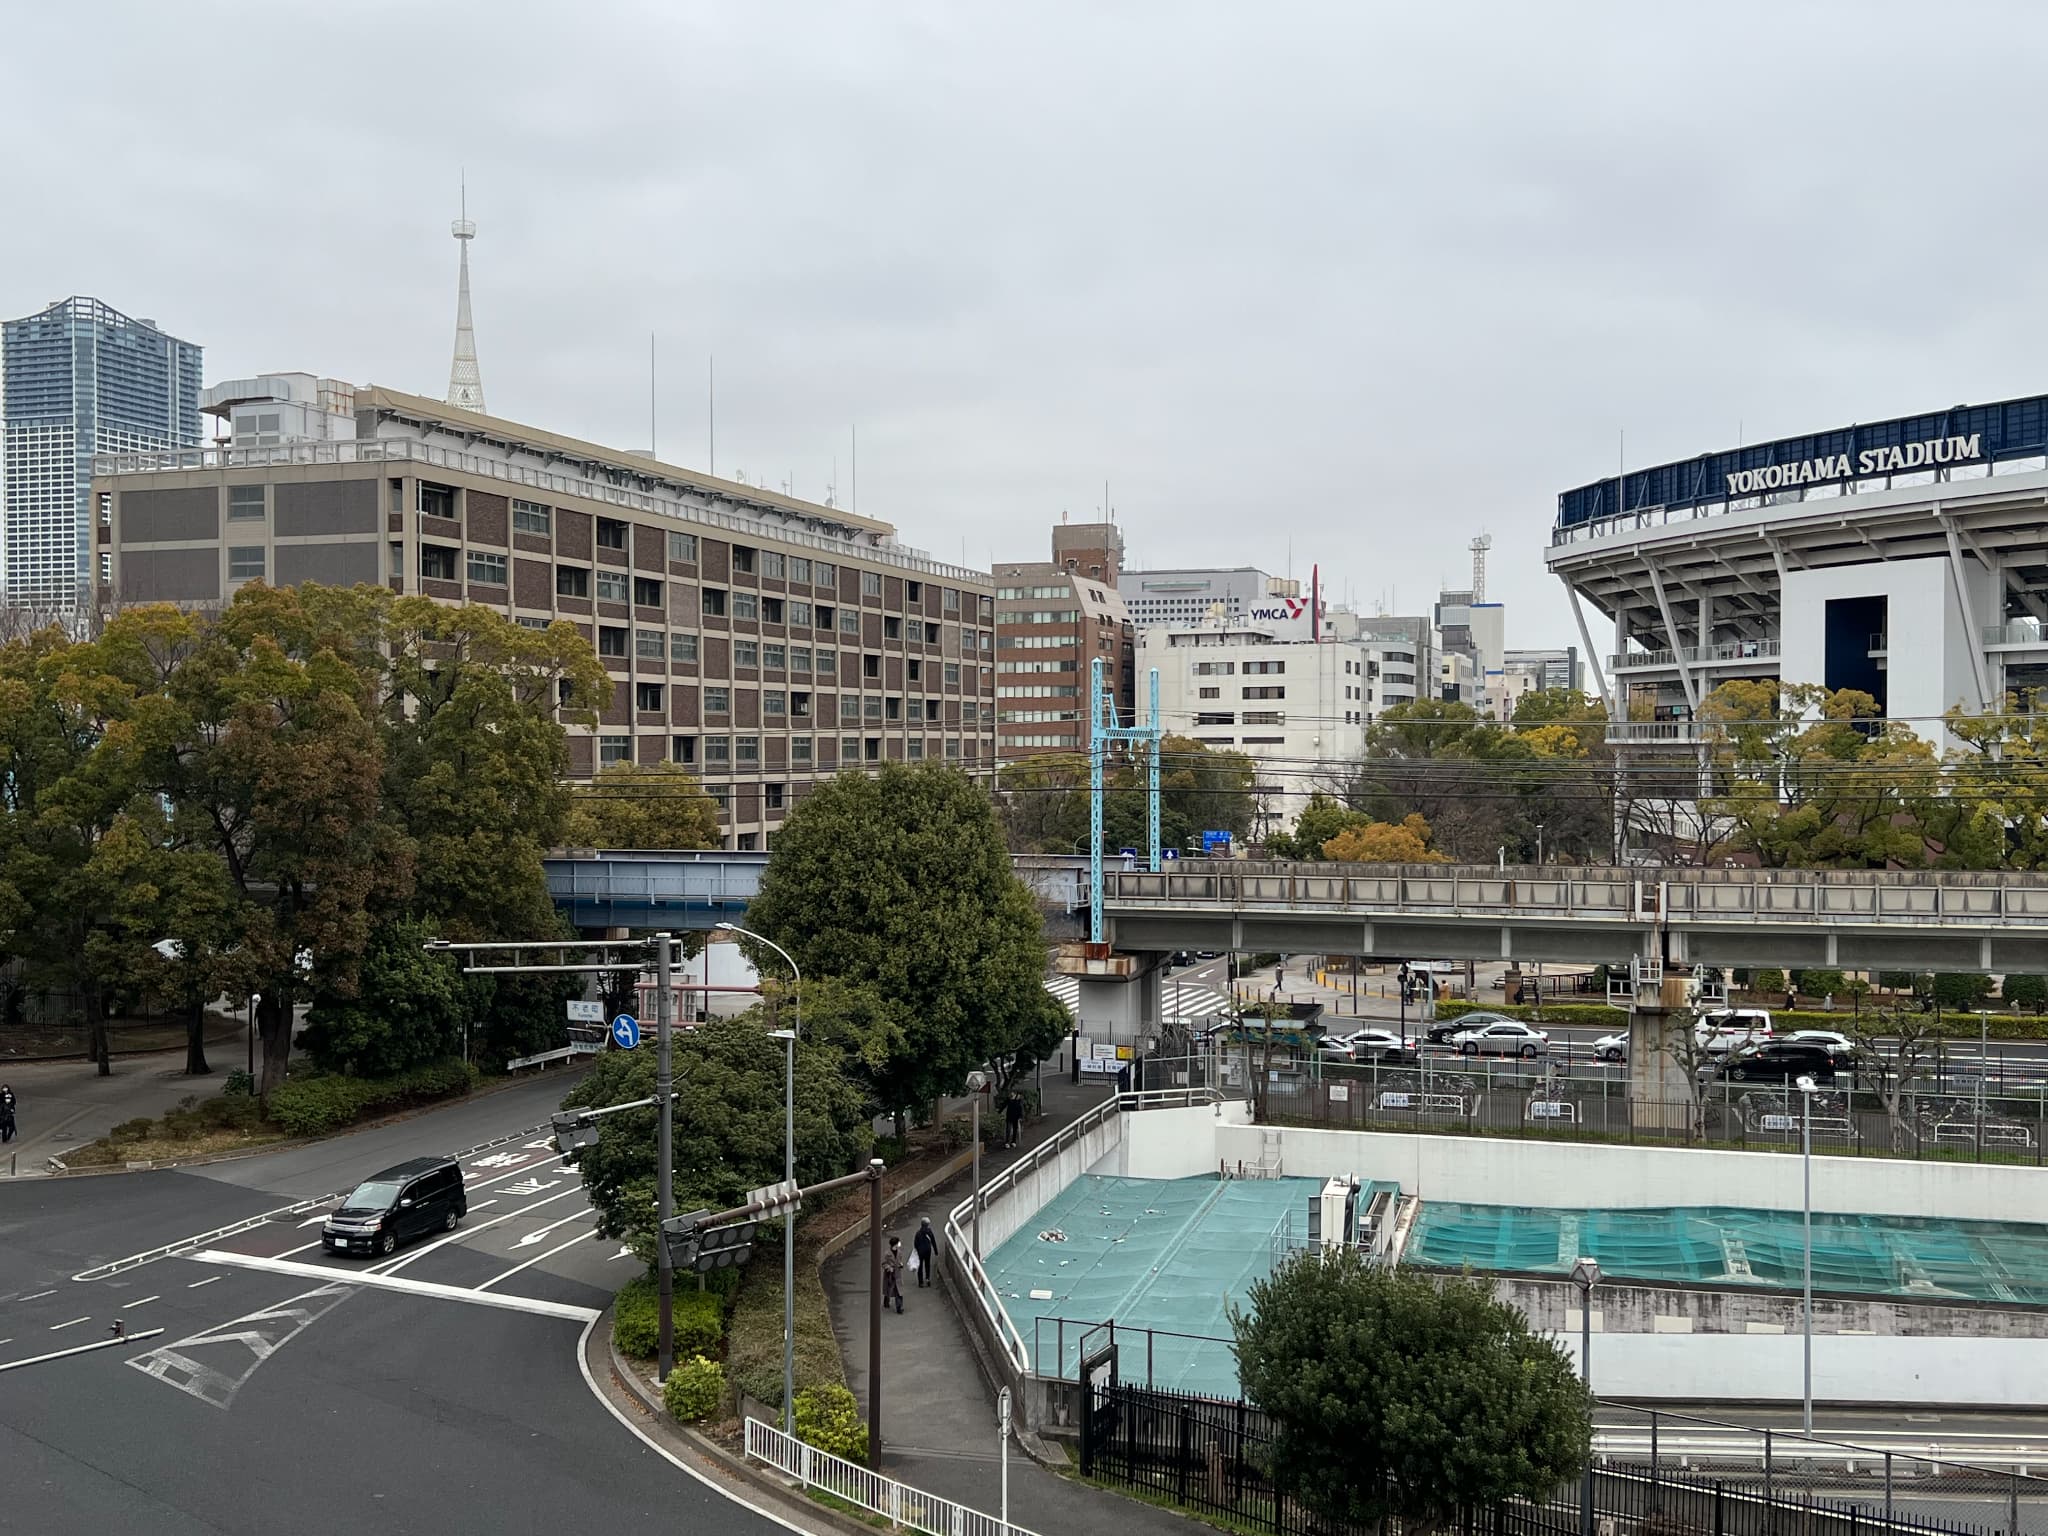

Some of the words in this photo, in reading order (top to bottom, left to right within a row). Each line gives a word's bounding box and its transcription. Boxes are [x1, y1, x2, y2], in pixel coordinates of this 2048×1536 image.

[1726, 453, 1853, 495] YOKOHAMA
[1858, 433, 1981, 474] STADIUM
[1251, 608, 1289, 620] YMCA
